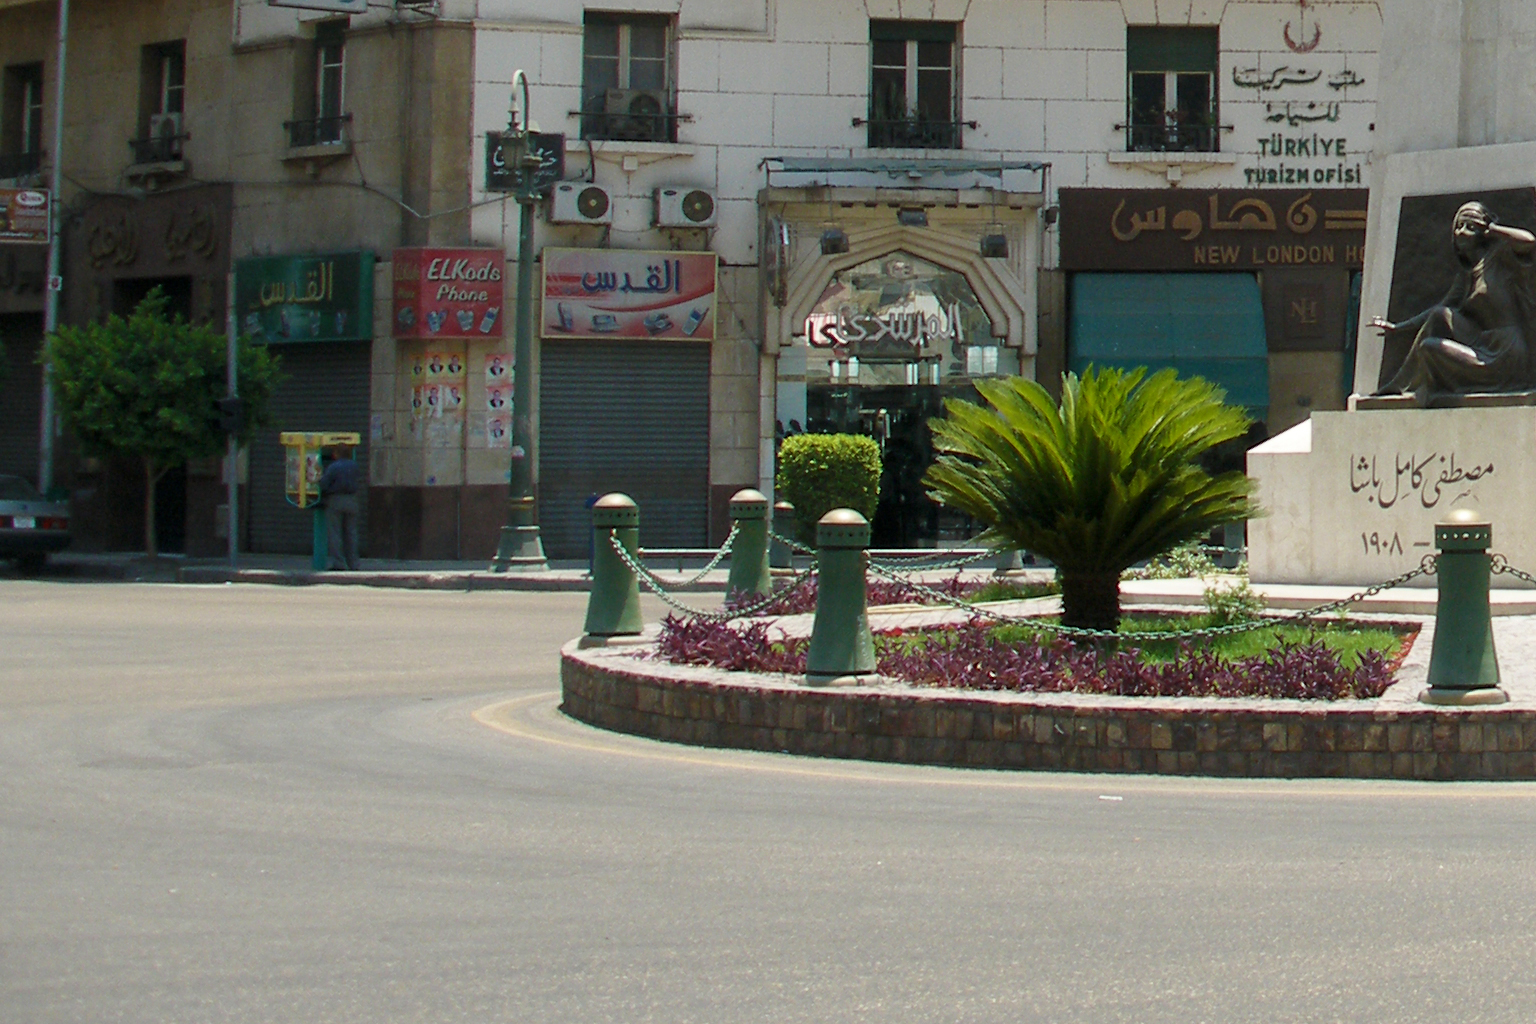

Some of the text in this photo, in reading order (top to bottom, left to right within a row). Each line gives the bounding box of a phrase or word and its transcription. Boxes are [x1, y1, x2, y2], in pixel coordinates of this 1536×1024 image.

[1257, 133, 1347, 157] TÜRKİYE
[1244, 163, 1361, 185] TURİZM OFİSİ
[1194, 245, 1241, 264] NEW
[1253, 245, 1335, 264] LONDON
[427, 258, 501, 281] ELKods
[580, 258, 681, 294] القدس
[260, 261, 334, 307] القدس
[436, 283, 489, 302] Phone
[1361, 531, 1404, 555] ١٩٠٨
